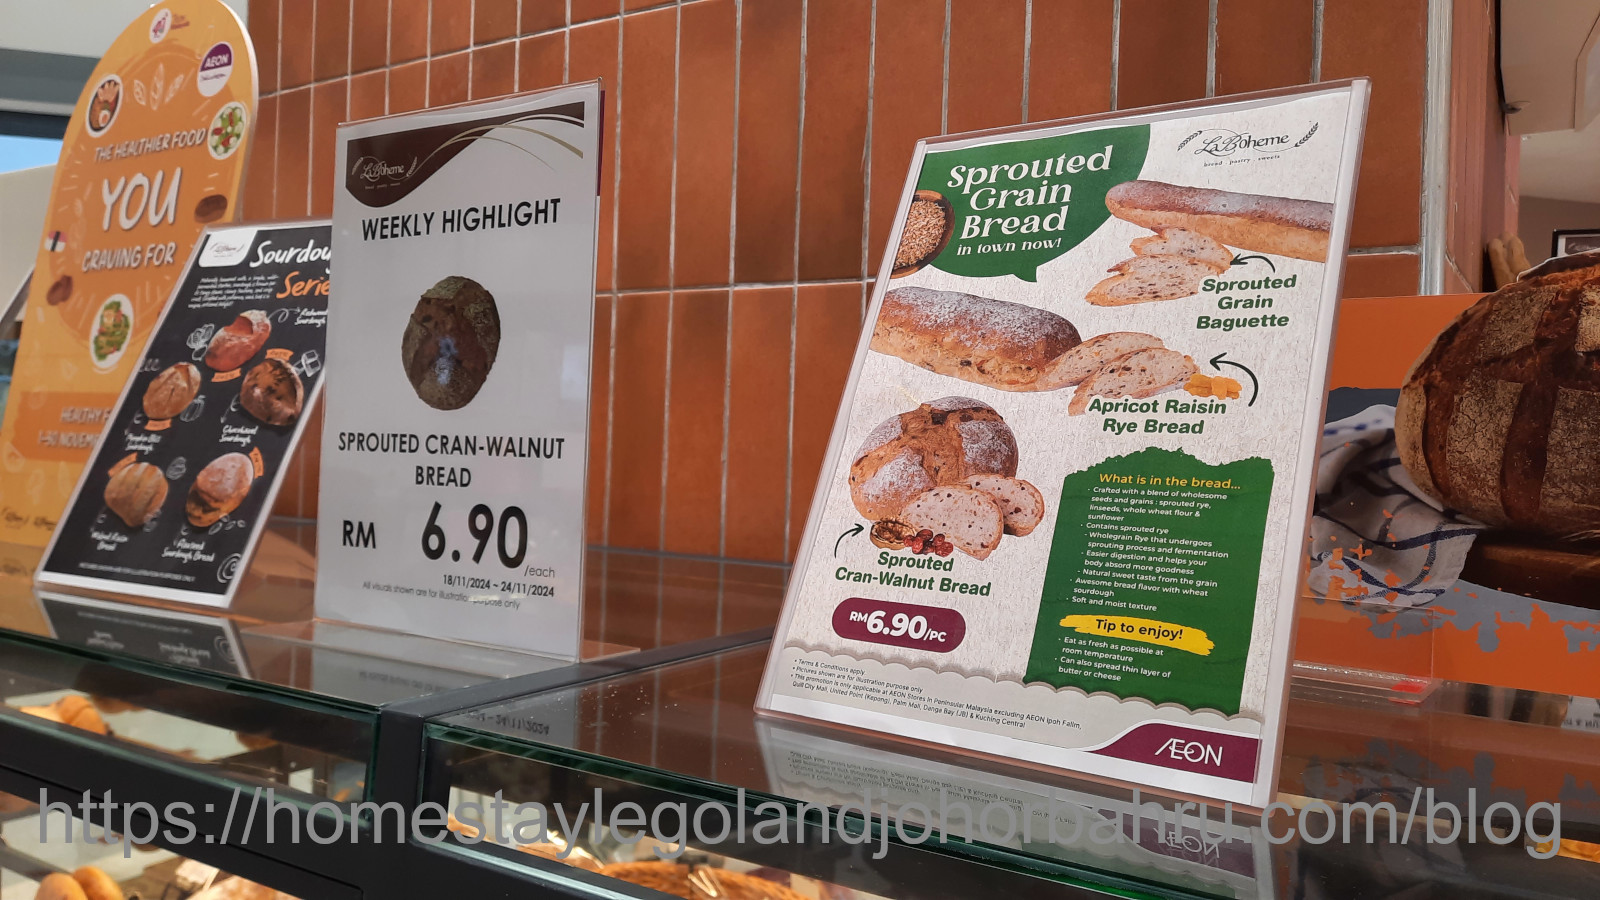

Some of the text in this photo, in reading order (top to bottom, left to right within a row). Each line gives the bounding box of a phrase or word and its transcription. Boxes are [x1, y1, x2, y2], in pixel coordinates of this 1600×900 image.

[94, 127, 207, 163] THE HEALTHIER FOOD
[947, 144, 1112, 194] Sprouted
[101, 167, 182, 231] YOU
[969, 182, 1072, 211] Grain
[362, 198, 561, 241] WEEKLY HIGHLIGHT
[960, 208, 1069, 241] Bread
[249, 238, 333, 268] Sourdou
[956, 237, 1061, 256] in town now!
[82, 242, 178, 273] CRAVING FOR
[276, 271, 331, 299] Serie
[1202, 274, 1297, 294] Sprouted
[1218, 295, 1273, 310] Grain
[1196, 314, 1290, 332] Baguette
[1089, 398, 1227, 415] Apricot Raisin
[1102, 418, 1204, 436] Rye Bread
[338, 432, 565, 459] SPROUTED CRAN-WALNUT
[414, 465, 472, 487] BREAD
[1100, 474, 1240, 490] What is in the bread...
[1093, 486, 1120, 494] Crafted
[1181, 491, 1228, 500] wholesome
[1090, 504, 1120, 514] linseeds,
[1130, 498, 1154, 506] grains
[1159, 500, 1194, 508] sprouted
[1196, 502, 1212, 510] rye,
[1088, 513, 1124, 522] sunflower
[1086, 522, 1118, 530] Contains
[1120, 525, 1155, 533] sprouted
[342, 501, 556, 579] RM 6.90 /each
[1090, 531, 1132, 542] Wholegrain
[1134, 534, 1148, 544] Rye
[1168, 538, 1212, 548] undergoes
[1086, 550, 1109, 558] Easier
[1110, 552, 1146, 561] digestion
[1166, 556, 1187, 566] helps
[1088, 542, 1124, 552] sprouting
[1175, 547, 1228, 558] fermentation
[878, 551, 955, 572] Sprouted
[1084, 559, 1103, 569] body
[1104, 561, 1131, 569] absord
[1156, 566, 1194, 575] goodness
[835, 566, 992, 596] Cran-Walnut Bread
[1082, 568, 1110, 577] Natural
[1136, 573, 1156, 581] taste
[1158, 575, 1178, 583] from
[443, 574, 554, 597] 18/11/2024 24/11/2024
[1074, 588, 1114, 598] sourdough
[1075, 577, 1112, 587] Awesome
[1114, 580, 1136, 589] bread
[1138, 583, 1160, 591] flavor
[1182, 587, 1208, 596] wheat
[1072, 596, 1086, 604] Soft
[1128, 601, 1158, 611] texture
[849, 610, 947, 643] RM6.90/PC
[1095, 619, 1184, 641] Tip to enjoy!
[1062, 648, 1134, 663] room temperature
[1064, 636, 1076, 644] Eat
[1088, 640, 1108, 650] fresh
[1120, 644, 1154, 656] possible
[1058, 666, 1082, 676] butter
[1094, 670, 1122, 682] cheese
[1060, 656, 1172, 678] Can also spread thin layer of
[966, 703, 992, 714] Malaysia
[994, 708, 1024, 720] excluding
[1026, 714, 1046, 723] AEON
